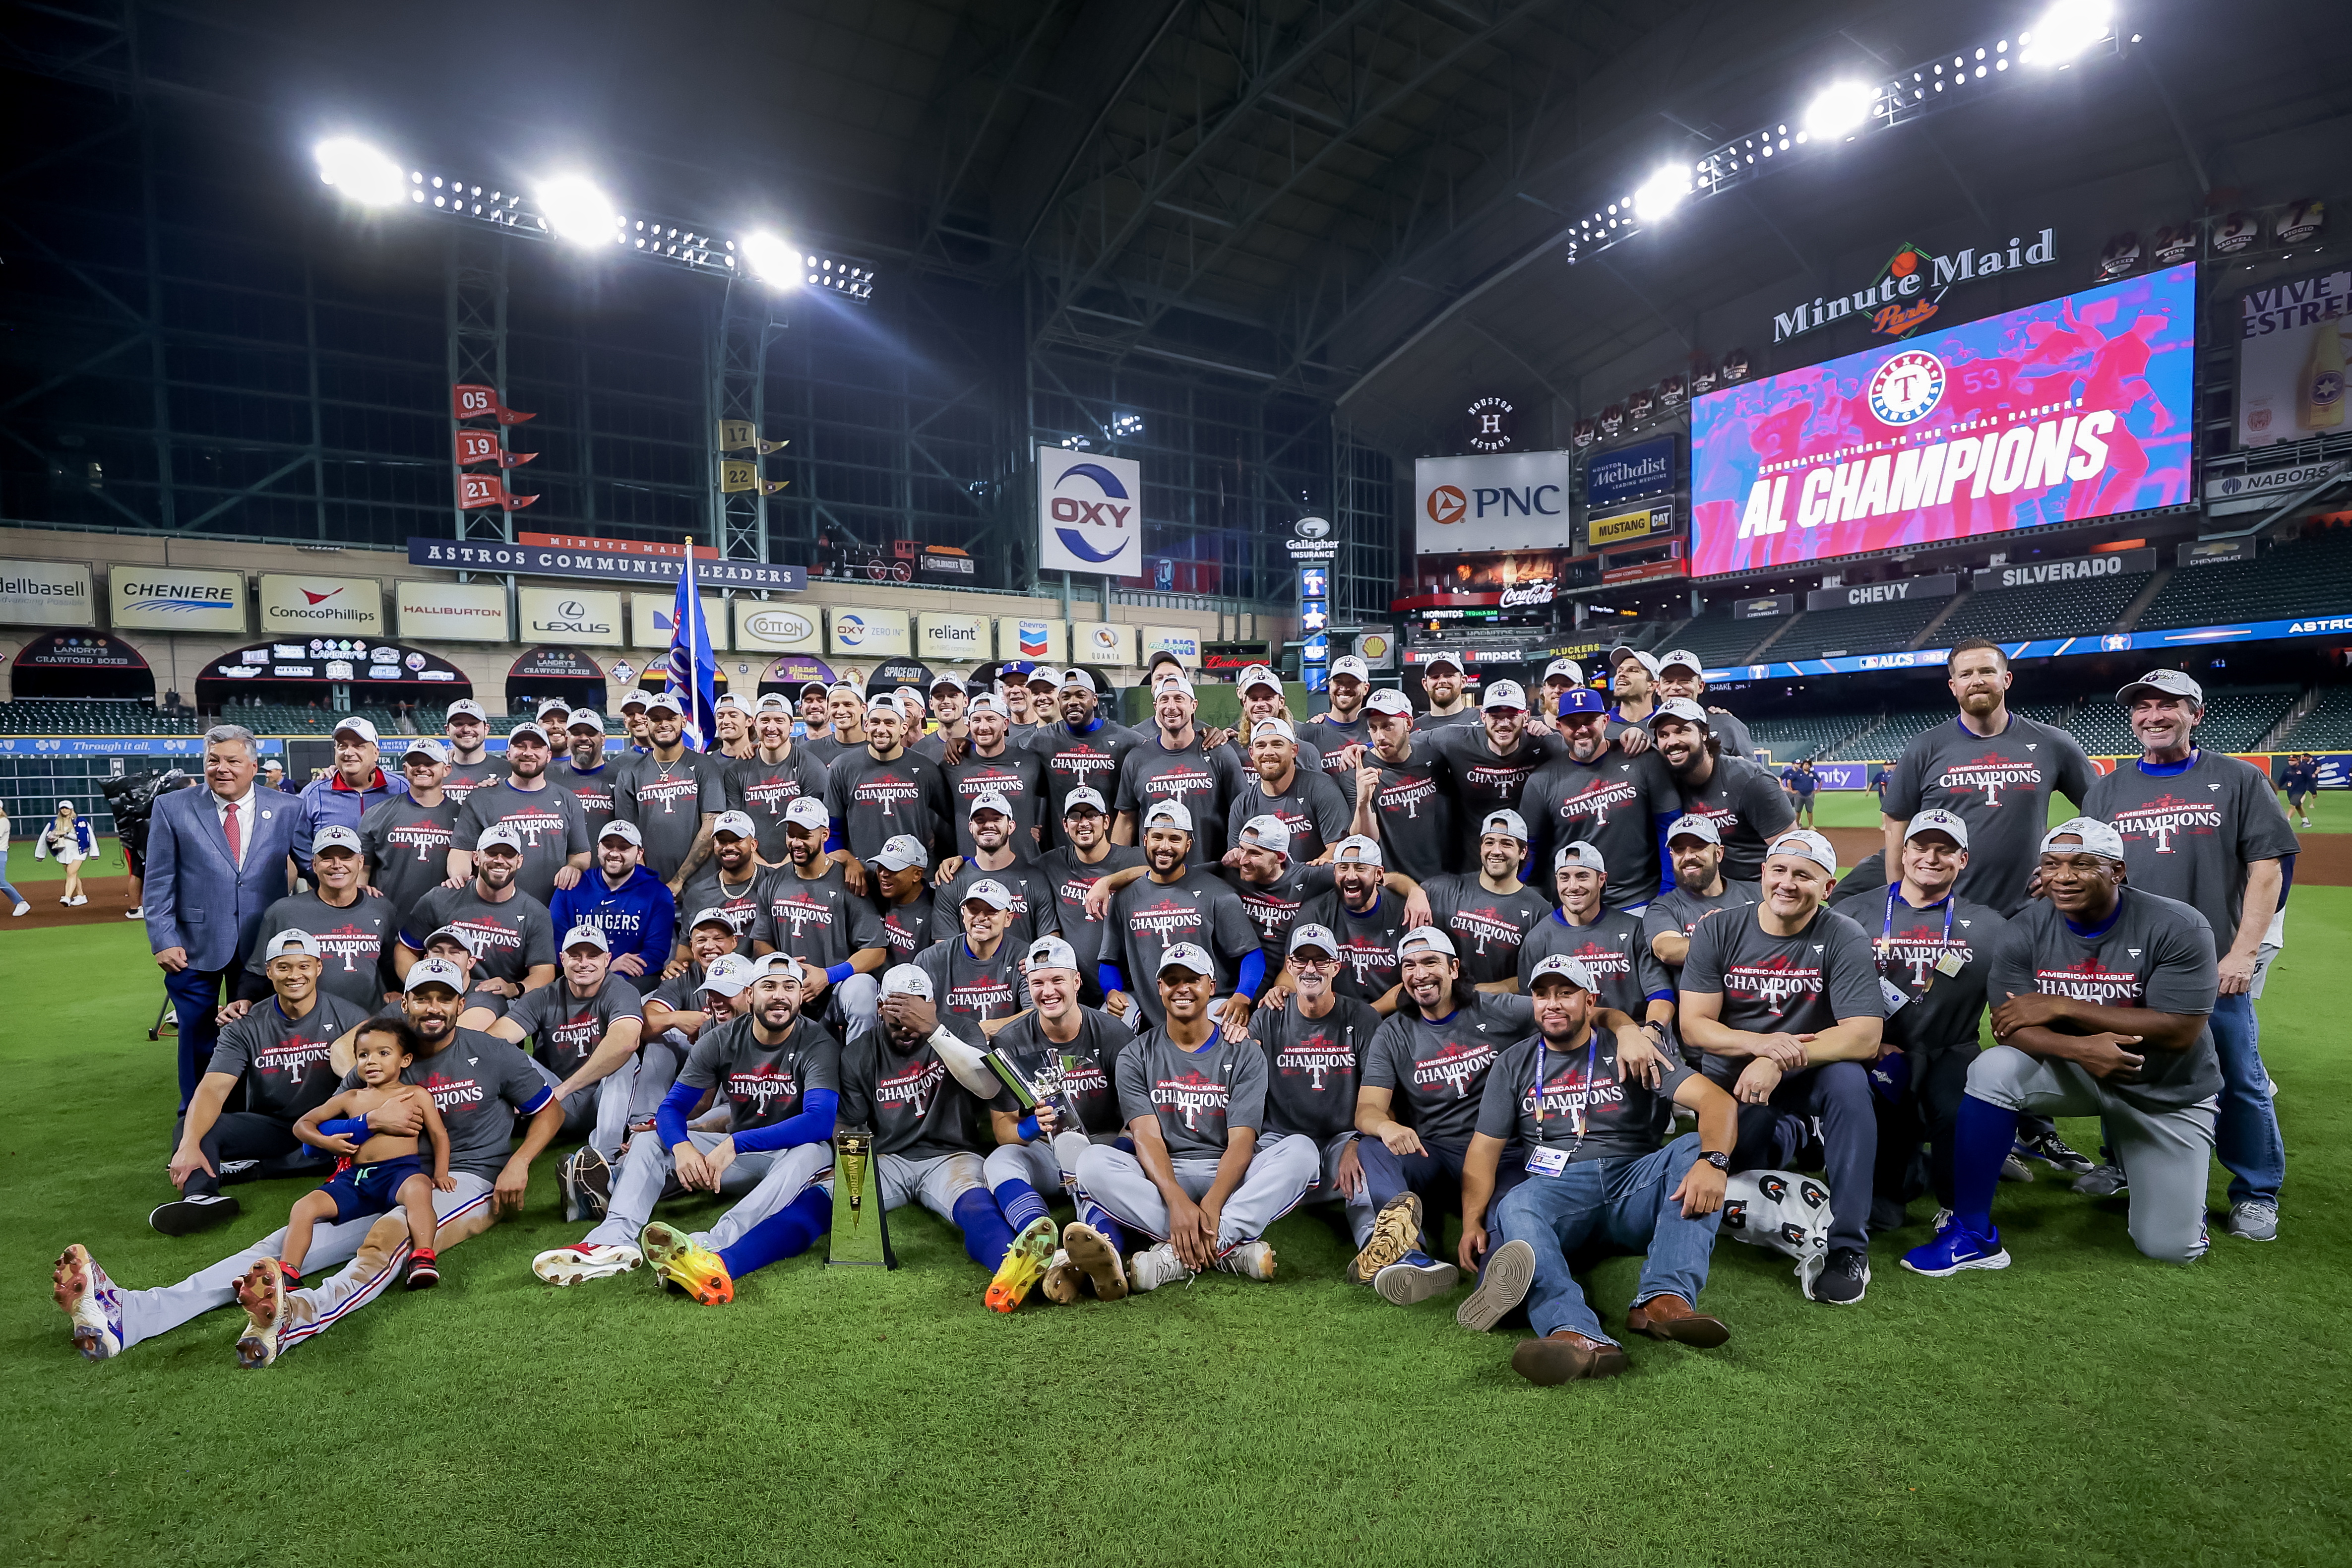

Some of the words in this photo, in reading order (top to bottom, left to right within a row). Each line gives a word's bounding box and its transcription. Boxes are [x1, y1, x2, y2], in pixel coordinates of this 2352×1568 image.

[2217, 236, 2252, 249] BAGWELL
[1773, 270, 1920, 344] Minute
[1931, 227, 2054, 289] Maid
[2250, 277, 2333, 313] VIVE
[1871, 299, 1938, 336] Park
[1881, 355, 1933, 380] TEXAS
[1894, 374, 1919, 403] T
[1964, 368, 1999, 393] 53
[462, 392, 488, 409] 05
[1468, 397, 1513, 416] HOUSTON
[1874, 387, 1939, 421] RANGERS
[1482, 414, 1500, 434] H
[729, 428, 747, 442] 17
[1471, 435, 1511, 451] ASTROS
[1759, 441, 1881, 474] CONGRATULATIONS
[1891, 437, 1906, 445] TO
[1915, 428, 1941, 439] THE
[1950, 416, 1997, 433] TEXAS
[2008, 398, 2083, 421] RANGERS
[466, 439, 490, 455] 19
[1593, 462, 1621, 472] HOUSTON
[1594, 457, 1667, 487] Methodist
[1737, 463, 1787, 539] AL
[1795, 408, 2117, 529] CHAMPIONS
[729, 470, 748, 483] 22
[2247, 465, 2330, 489] NABORS
[467, 482, 490, 498] 21
[1473, 485, 1560, 518] PNC
[1052, 497, 1131, 528] OXY
[1599, 518, 1645, 537] MUSTANG
[1651, 512, 1669, 527] CAT
[550, 537, 627, 550] MINUTE
[1286, 539, 1339, 551] Gallagher
[428, 546, 525, 564] ASTROS
[539, 554, 685, 575] COMMUNITY
[698, 564, 792, 583] LEADERS
[2190, 554, 2241, 566] CHEVROLET
[2002, 556, 2122, 586] SILVERADO
[0, 577, 84, 597] ellbasell
[124, 583, 233, 600] CHENIERE
[1304, 576, 1324, 595] T
[1849, 582, 1910, 605] CHEVY
[269, 606, 374, 623] ConocoPhillips
[403, 605, 501, 618] HALLIBURTON
[1422, 610, 1464, 619] HORNITOS
[1747, 609, 1780, 618] CHEVROLET
[533, 621, 610, 633] LEXUS
[753, 617, 803, 637] COTTON
[837, 626, 865, 634] OXY
[929, 625, 976, 640] reliant
[54, 646, 108, 655] LANDRY'S
[310, 649, 367, 660] LANDRY'S
[1149, 642, 1189, 650] FREEPORT
[1164, 638, 1196, 655] LNG
[1550, 643, 1600, 656] PLUCKERS
[36, 656, 93, 664] CRAWFORD
[1092, 652, 1119, 660] QUANTA
[1476, 649, 1521, 662] impact
[1878, 654, 1915, 668] ALCS
[789, 664, 818, 674] planet
[793, 672, 823, 681] fitness
[884, 666, 907, 678] SPACE
[907, 667, 923, 678] CITY
[1752, 665, 1765, 678] T
[72, 742, 123, 752] Through
[124, 741, 134, 751] it
[135, 742, 151, 751] all.
[1939, 769, 2041, 788] CHAMPIONS
[854, 787, 919, 800] CHAMPIONS
[2116, 807, 2167, 819] AMERICAN
[2170, 804, 2214, 813] LEAGUE
[2108, 811, 2221, 834] CHAMPIONS
[575, 915, 641, 932] RANGERS
[771, 906, 833, 924] CHAMPIONS
[1130, 914, 1202, 931] CHAMPIONS
[417, 961, 437, 974] WORLD
[438, 961, 455, 974] SERIES
[1537, 956, 1558, 972] WORLD
[1559, 956, 1576, 973] SERIES
[1732, 967, 1782, 976] AMERICAN
[1724, 974, 1823, 993] CHAMPIONS
[255, 1048, 331, 1067] CHAMPIONS
[263, 1045, 297, 1055] AMERICAN
[1418, 1055, 1458, 1068] AMERICAN
[1459, 1044, 1489, 1059] LEAGUE
[1277, 1052, 1356, 1068] CHAMPIONS
[1414, 1050, 1499, 1085] CHAMPIONS
[882, 1073, 919, 1087] AMERICAN
[919, 1061, 939, 1075] LEAGUE
[876, 1066, 945, 1102] CHAMPIONS
[847, 1154, 859, 1205] AMERICAN
